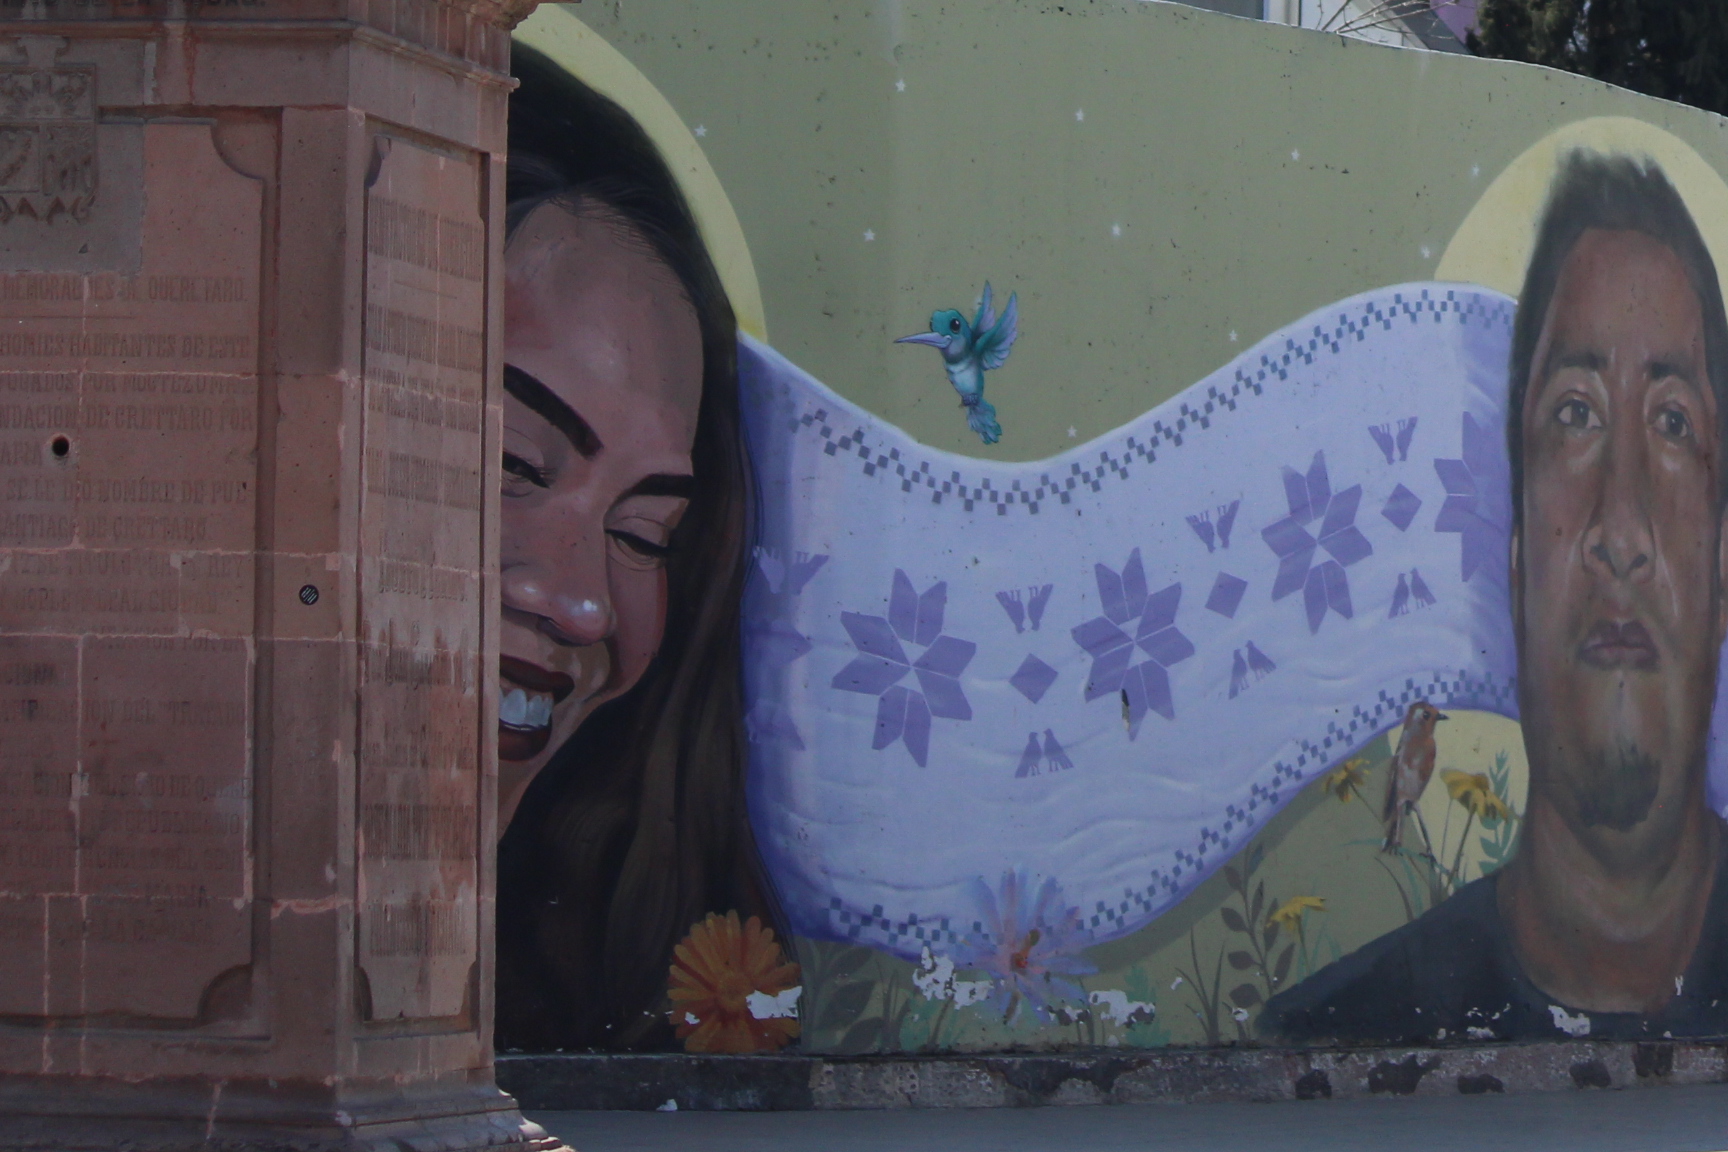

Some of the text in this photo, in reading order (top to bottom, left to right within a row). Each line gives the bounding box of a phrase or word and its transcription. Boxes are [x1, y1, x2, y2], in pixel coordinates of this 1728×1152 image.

[182, 335, 205, 359] DE
[86, 405, 109, 430] DE
[220, 406, 254, 431] POR
[182, 480, 205, 504] DE
[84, 515, 107, 539] DE
